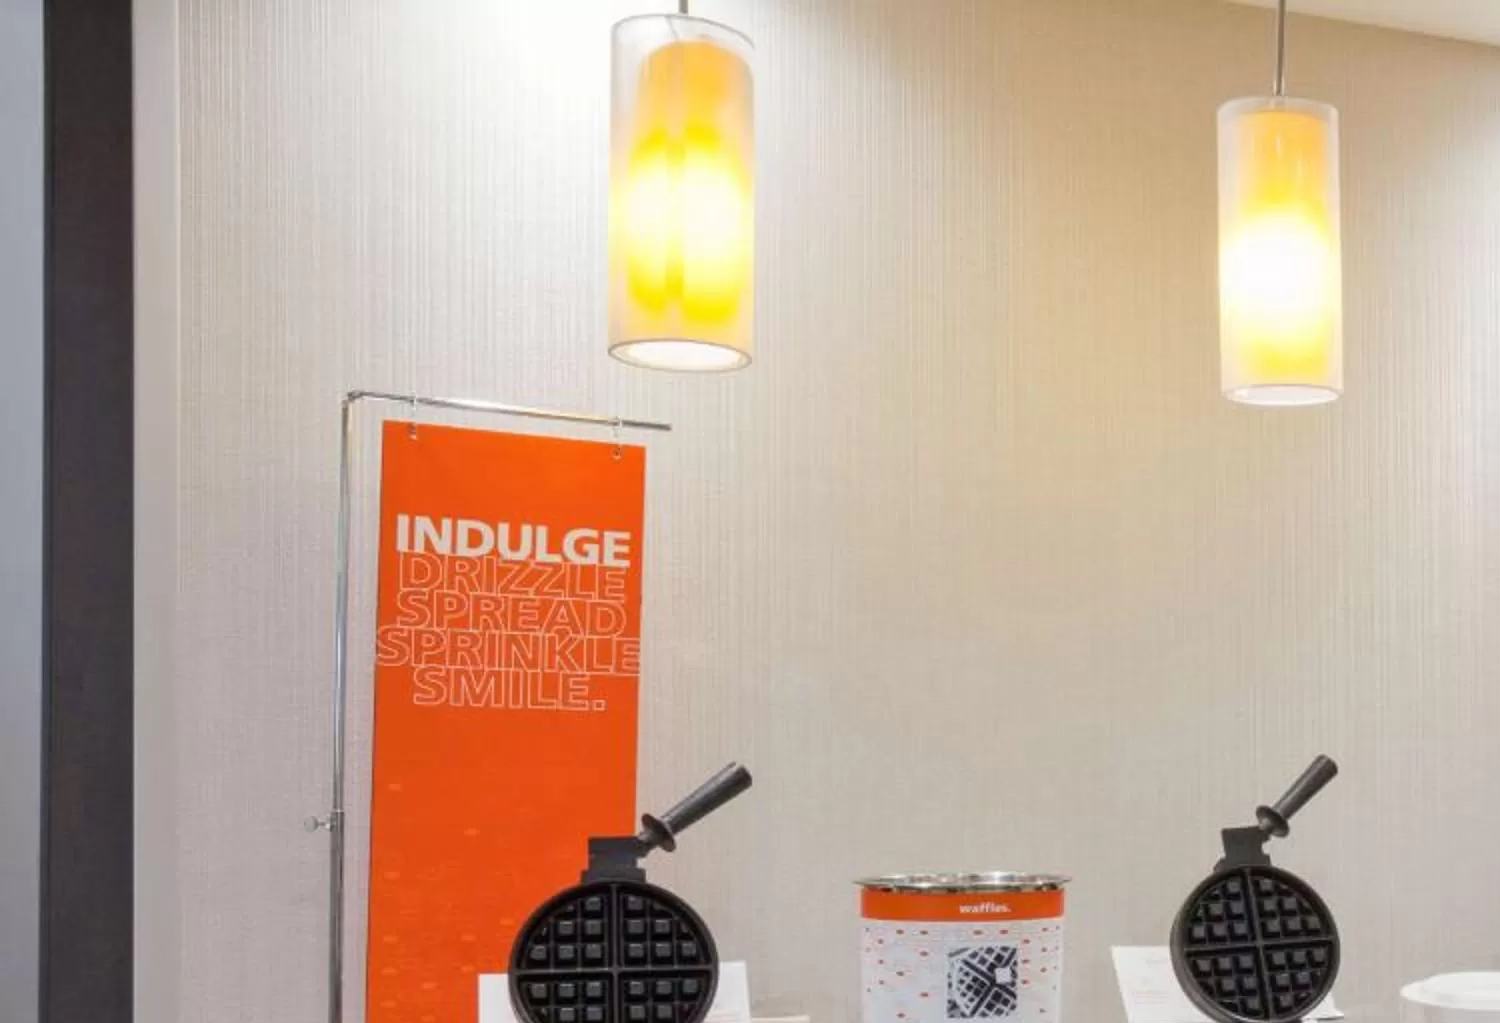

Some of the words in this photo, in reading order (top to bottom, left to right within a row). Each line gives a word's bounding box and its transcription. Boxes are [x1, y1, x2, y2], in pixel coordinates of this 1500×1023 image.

[396, 514, 631, 568] INDULGE
[399, 552, 628, 601] DRIZZLE
[396, 589, 628, 638] SPREAD
[376, 623, 641, 676] SPRINKLE
[412, 664, 607, 712] SMILE.
[959, 902, 1012, 914] waffles.
